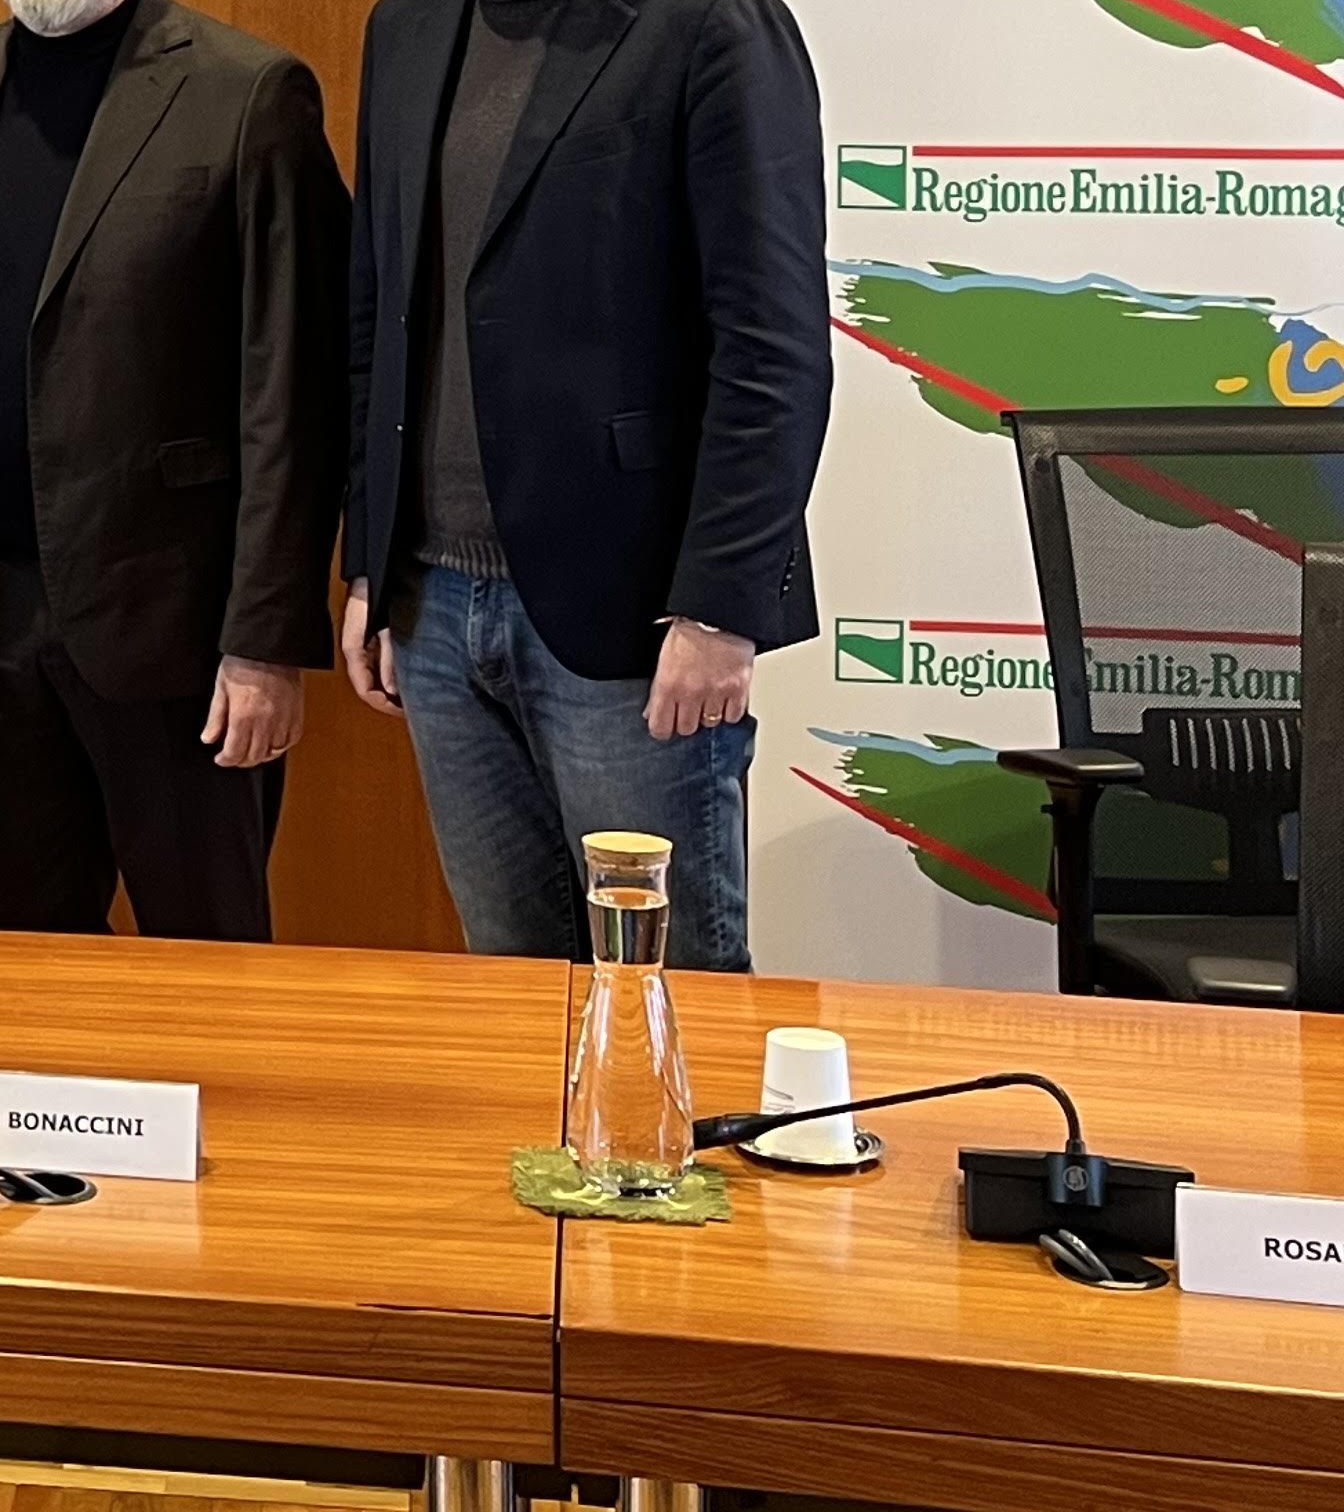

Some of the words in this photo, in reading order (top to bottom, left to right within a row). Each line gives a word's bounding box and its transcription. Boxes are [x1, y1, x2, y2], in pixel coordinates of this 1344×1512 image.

[911, 167, 1067, 223] Regione
[8, 1111, 145, 1137] BONACCINI
[1264, 1236, 1344, 1263] ROSA
